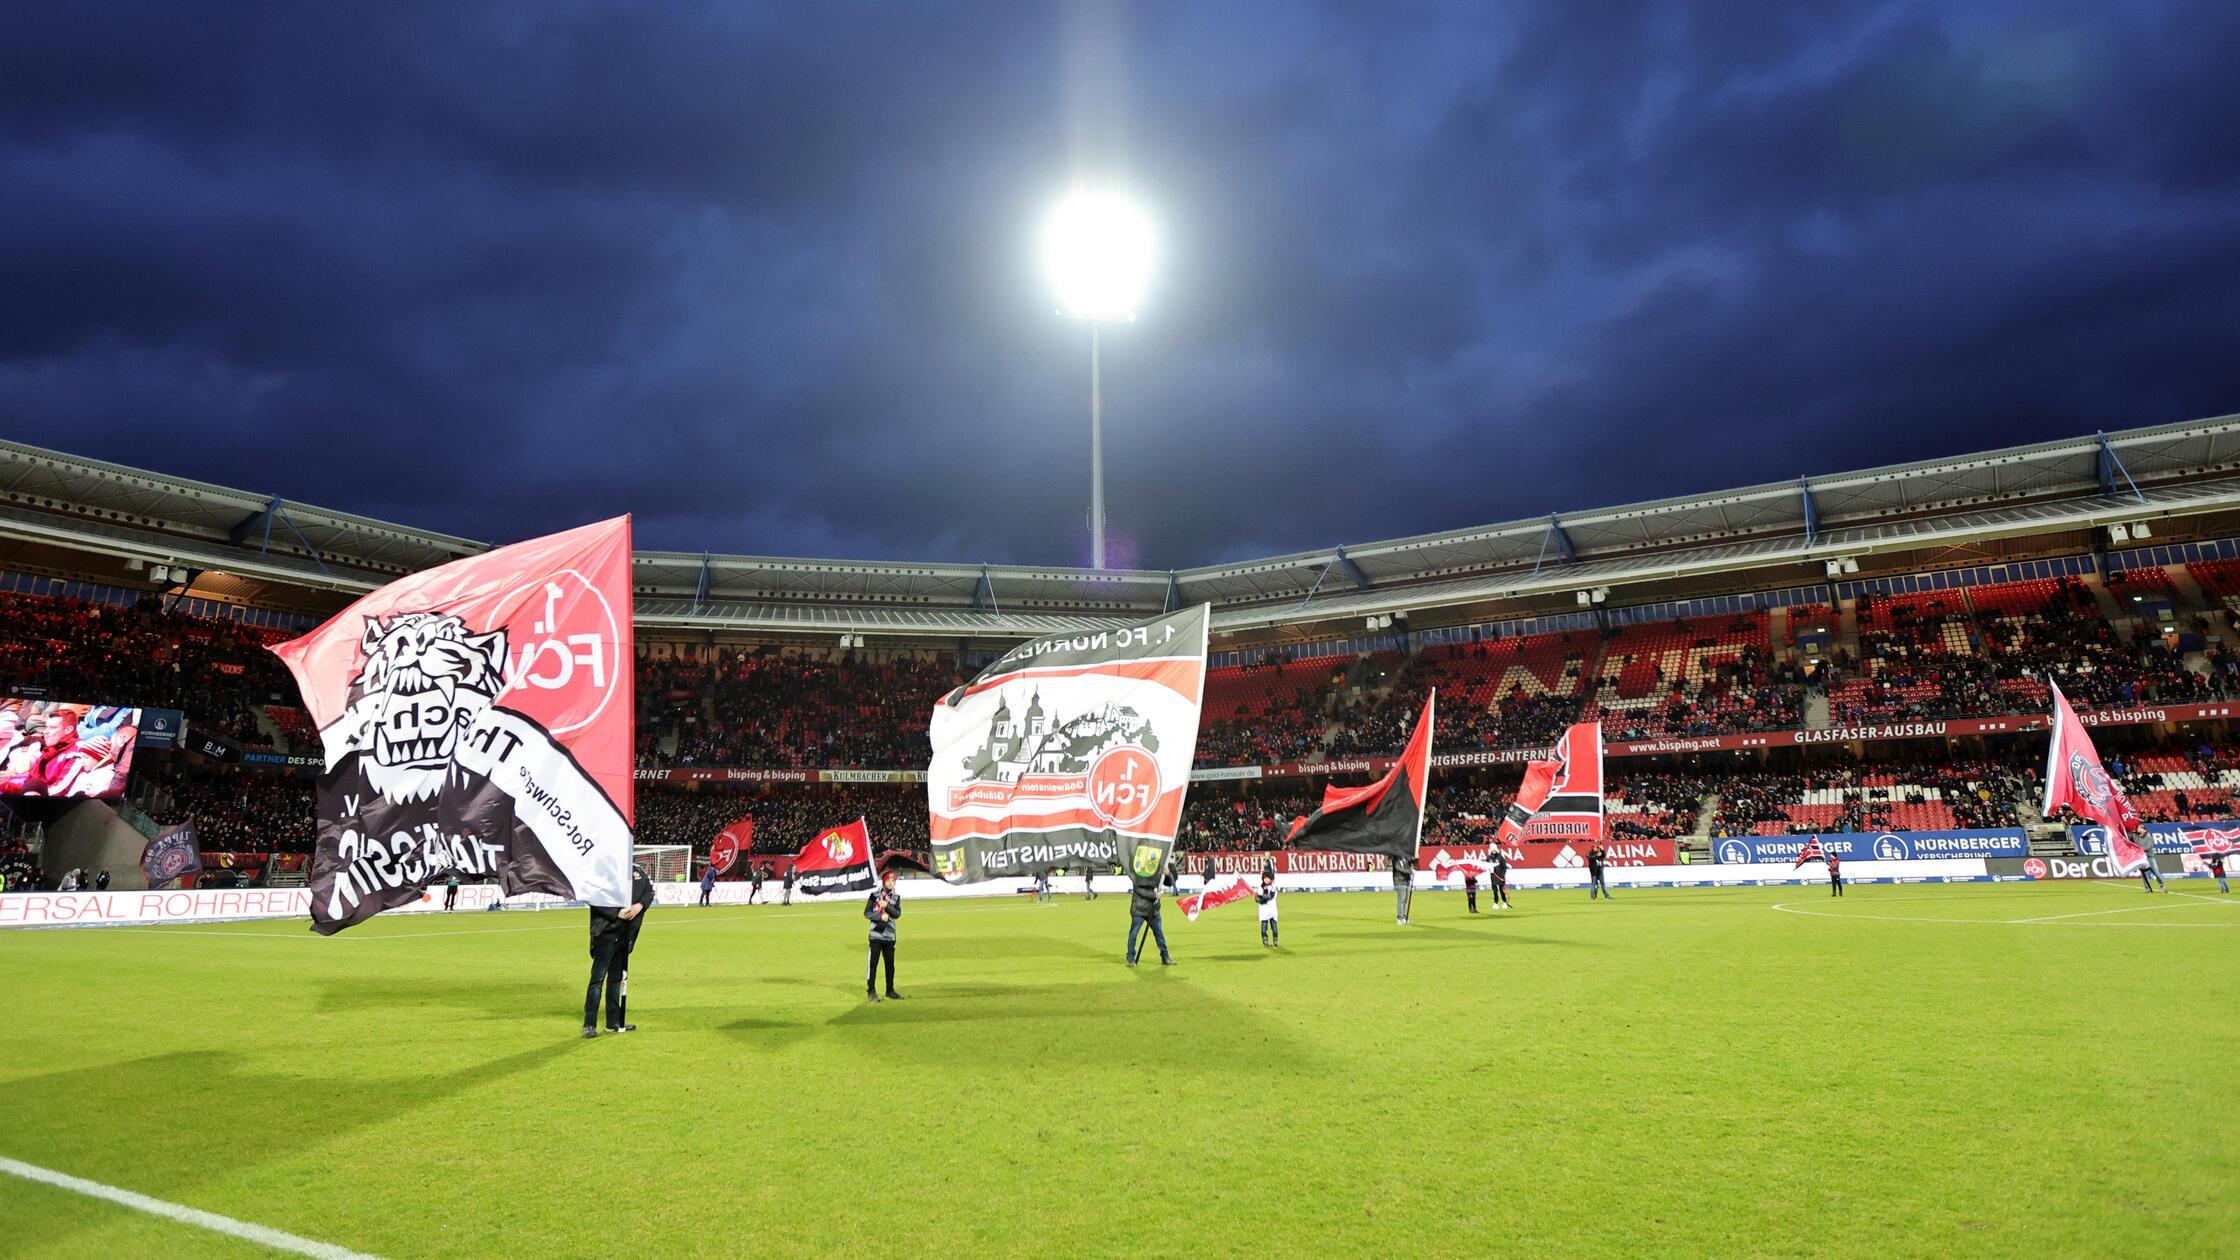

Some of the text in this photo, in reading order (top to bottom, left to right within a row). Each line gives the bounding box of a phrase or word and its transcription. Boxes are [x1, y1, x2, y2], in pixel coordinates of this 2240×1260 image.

[2100, 712, 2111, 722] &
[2112, 709, 2166, 724] bisping
[1794, 722, 1947, 743] GLASFASER-AUSBAU
[1629, 737, 1721, 753] www.bisping.net
[244, 753, 286, 764] PARTNER
[287, 756, 305, 765] DES
[1298, 760, 1370, 774] bisping & bisping
[727, 769, 806, 783] bisping & bisping
[832, 771, 888, 782] KULMBACHER
[1606, 844, 1658, 858] ALINA
[1914, 837, 2021, 851] NÜRNBERGER
[1287, 852, 1386, 872] KULMBACHER
[2051, 858, 2088, 878] Der
[0, 894, 124, 922] ERSAL
